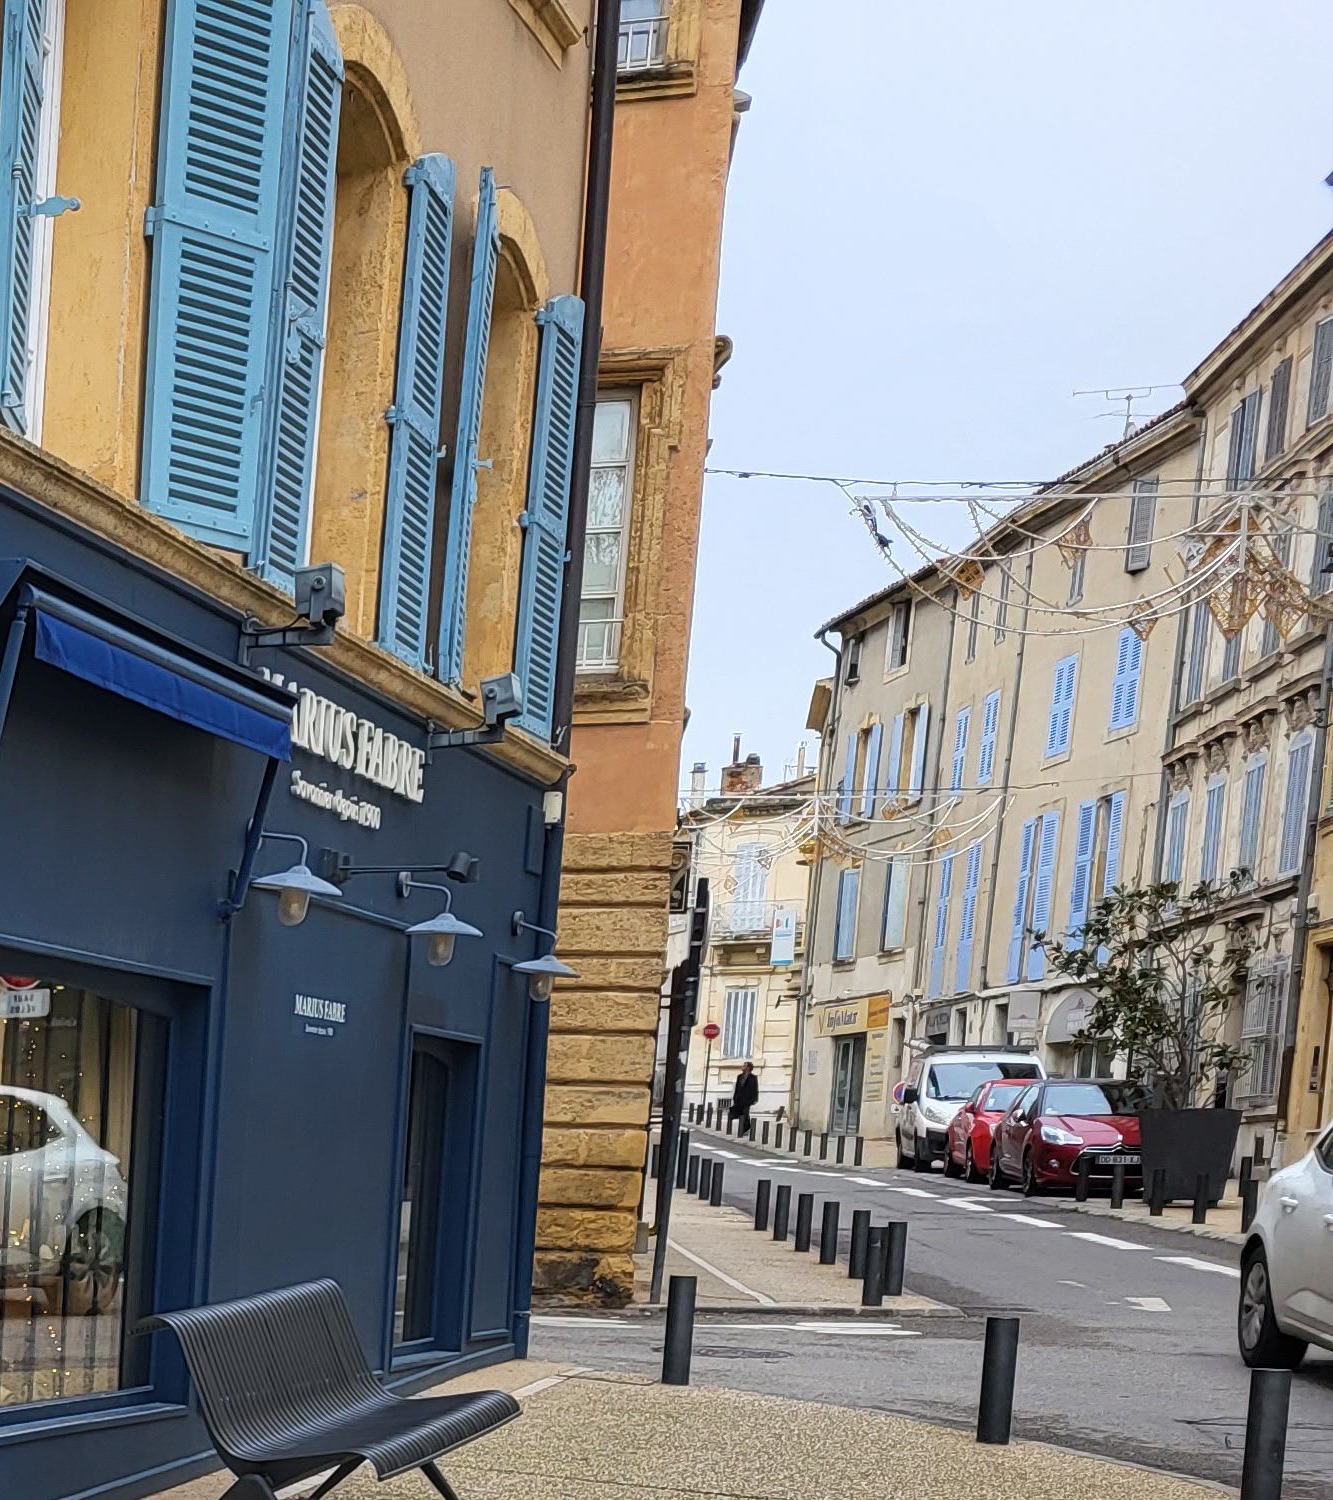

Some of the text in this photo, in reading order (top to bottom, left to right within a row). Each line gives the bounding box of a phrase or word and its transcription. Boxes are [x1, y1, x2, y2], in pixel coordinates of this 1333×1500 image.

[354, 719, 426, 804] FABRE
[294, 994, 346, 1023] MARIUS FABRE
